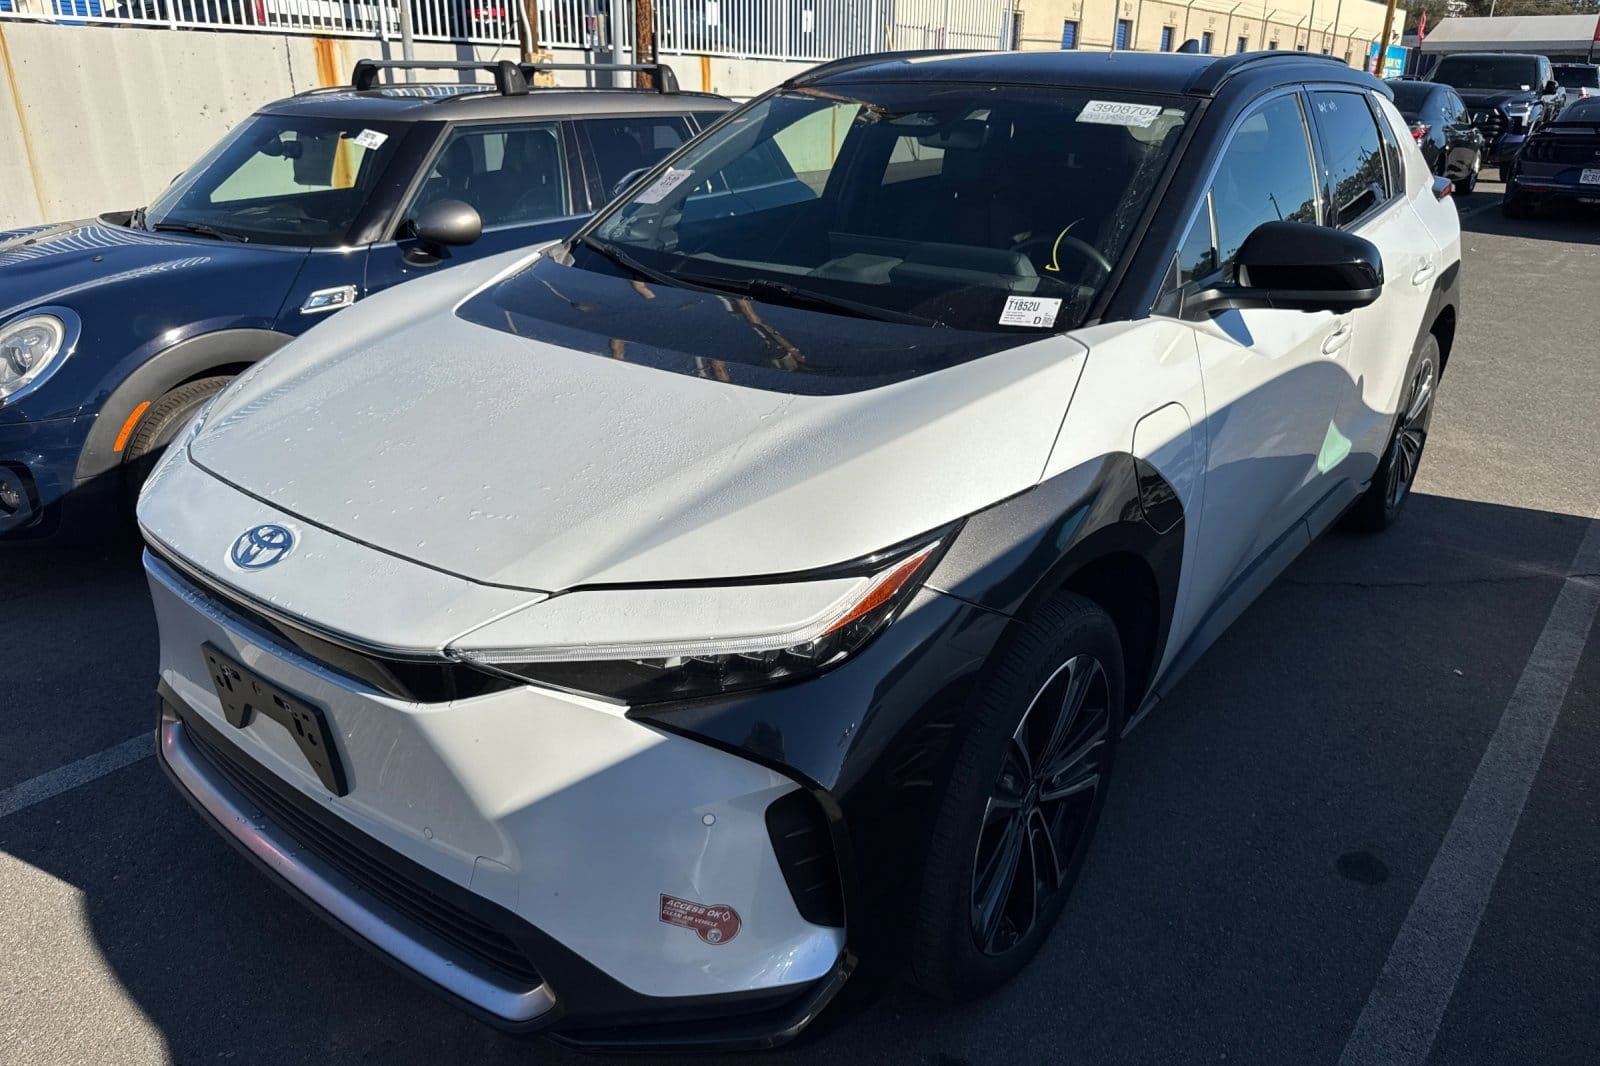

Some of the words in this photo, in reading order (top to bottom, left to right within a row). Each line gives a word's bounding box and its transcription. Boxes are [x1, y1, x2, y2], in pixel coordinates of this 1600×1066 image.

[1092, 103, 1159, 117] 3908704
[1008, 300, 1041, 312] T1852U
[1033, 316, 1042, 325] D
[666, 899, 706, 914] ACCESS
[662, 909, 683, 919] CLEAN
[694, 917, 719, 928] VEHICLE
